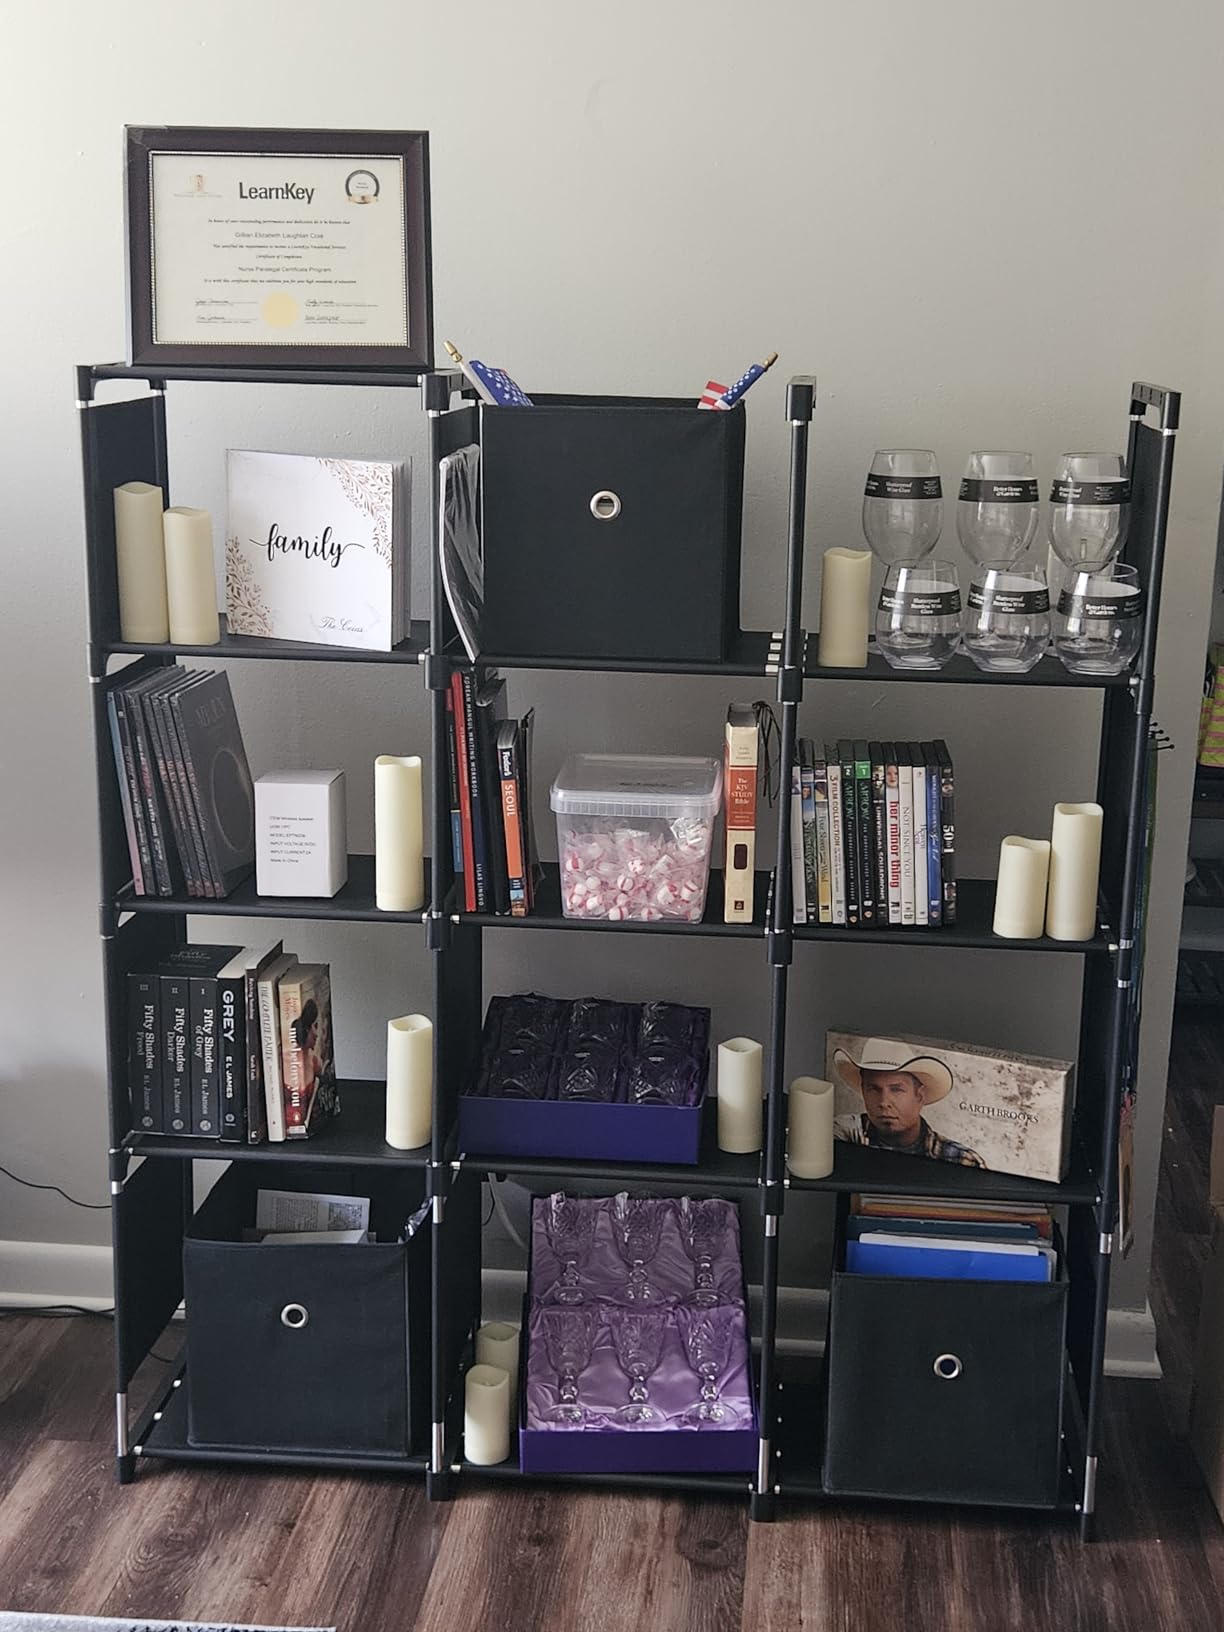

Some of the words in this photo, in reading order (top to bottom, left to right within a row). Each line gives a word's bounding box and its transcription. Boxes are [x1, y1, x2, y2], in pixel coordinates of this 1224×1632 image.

[238, 182, 315, 204] LearnKey
[249, 523, 365, 568] family
[463, 675, 472, 701] KOREAN
[470, 762, 478, 798] WORKBOOK
[830, 774, 838, 782] 3
[505, 784, 515, 817] SEOUL
[831, 783, 839, 800] FILM
[845, 782, 854, 820] ARROW
[859, 781, 869, 819] ARROW
[890, 800, 900, 820] her
[902, 806, 911, 828] NOT
[832, 801, 840, 846] COLLECTION
[943, 824, 954, 841] 50
[890, 824, 900, 857] minor
[903, 830, 911, 857] SINCE
[877, 852, 885, 900] SQUADRONS
[890, 859, 900, 888] thing
[904, 859, 912, 878] YOU
[143, 1004, 154, 1030] Fifty
[174, 1007, 185, 1033] Fifty
[203, 1008, 214, 1034] Fifty
[222, 990, 235, 1042] GREY
[195, 1025, 203, 1034] of
[288, 1027, 297, 1047] me
[145, 1032, 155, 1069] Shades
[167, 1031, 175, 1062] Darker
[175, 1035, 186, 1073] Shades
[194, 1036, 203, 1058] Grey
[204, 1036, 214, 1074] Shades
[290, 1047, 302, 1085] before
[201, 1090, 209, 1115] James
[288, 1085, 300, 1107] you
[959, 1101, 996, 1117] GARTH
[997, 1109, 1039, 1124] BROOKS
